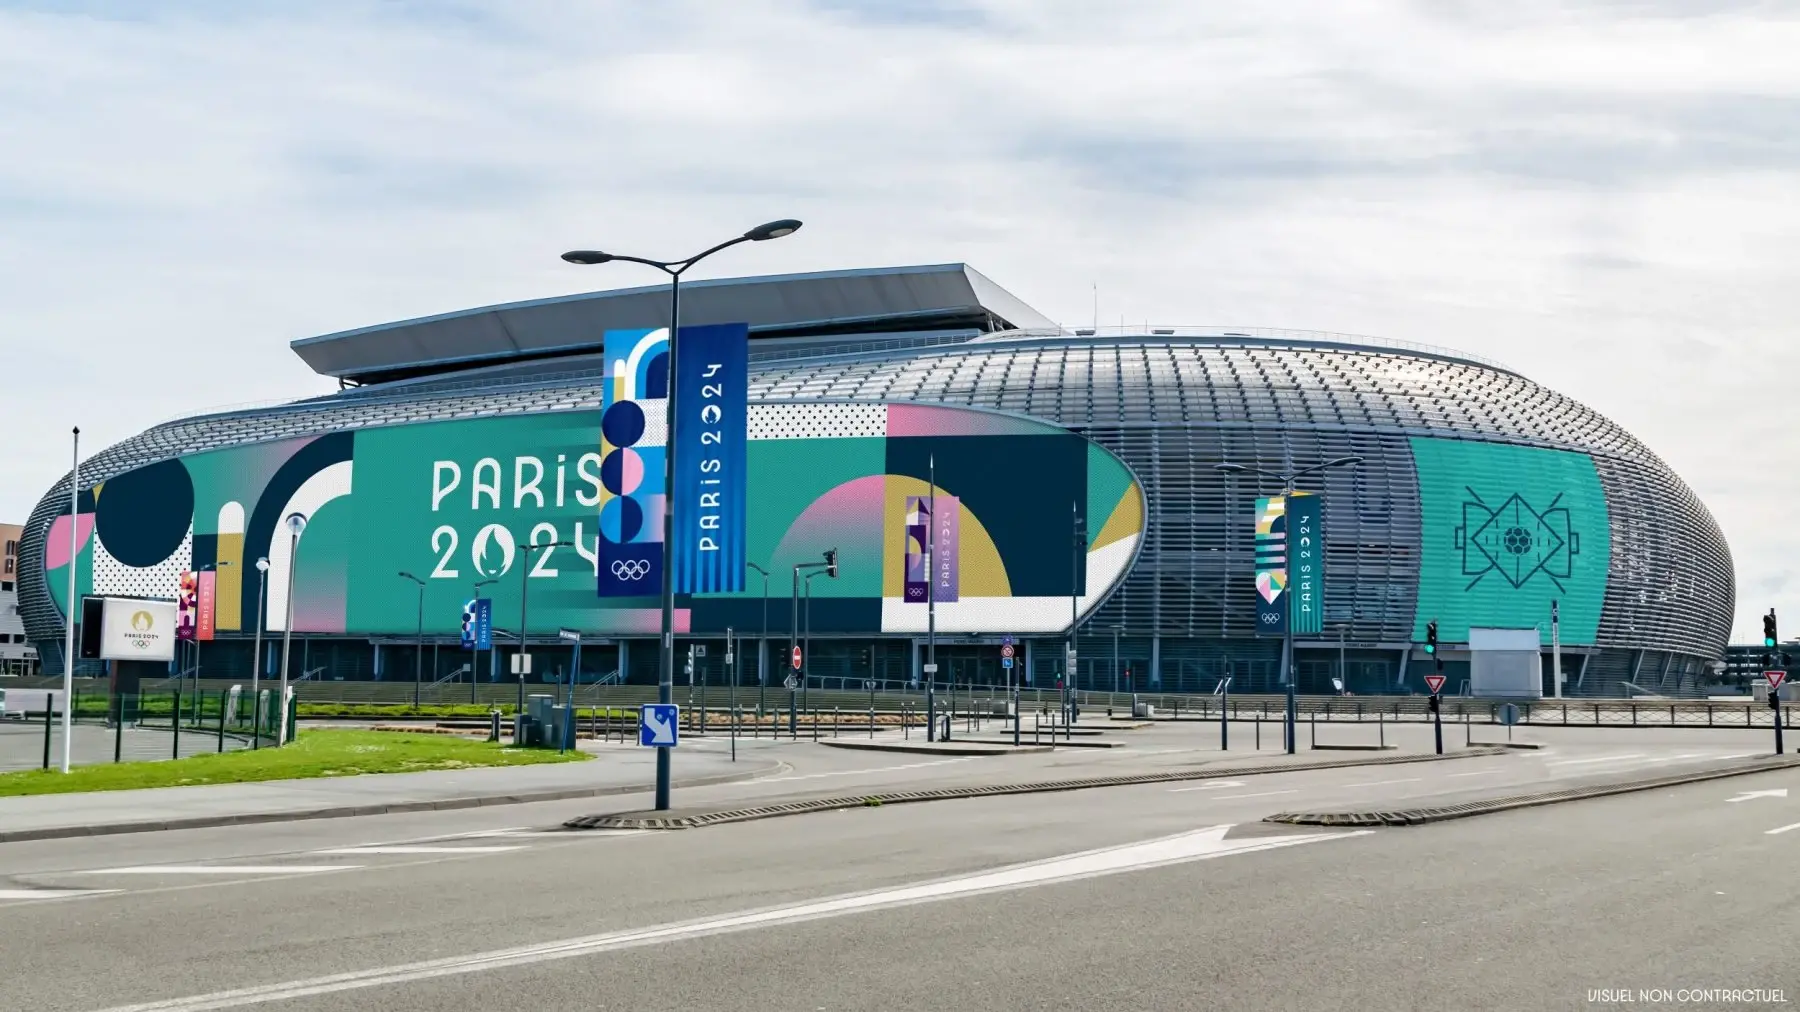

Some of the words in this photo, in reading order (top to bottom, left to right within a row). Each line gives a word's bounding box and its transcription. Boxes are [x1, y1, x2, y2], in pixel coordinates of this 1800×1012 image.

[700, 363, 722, 445] 2024
[430, 522, 600, 578] 2024
[1300, 515, 1311, 558] 2024
